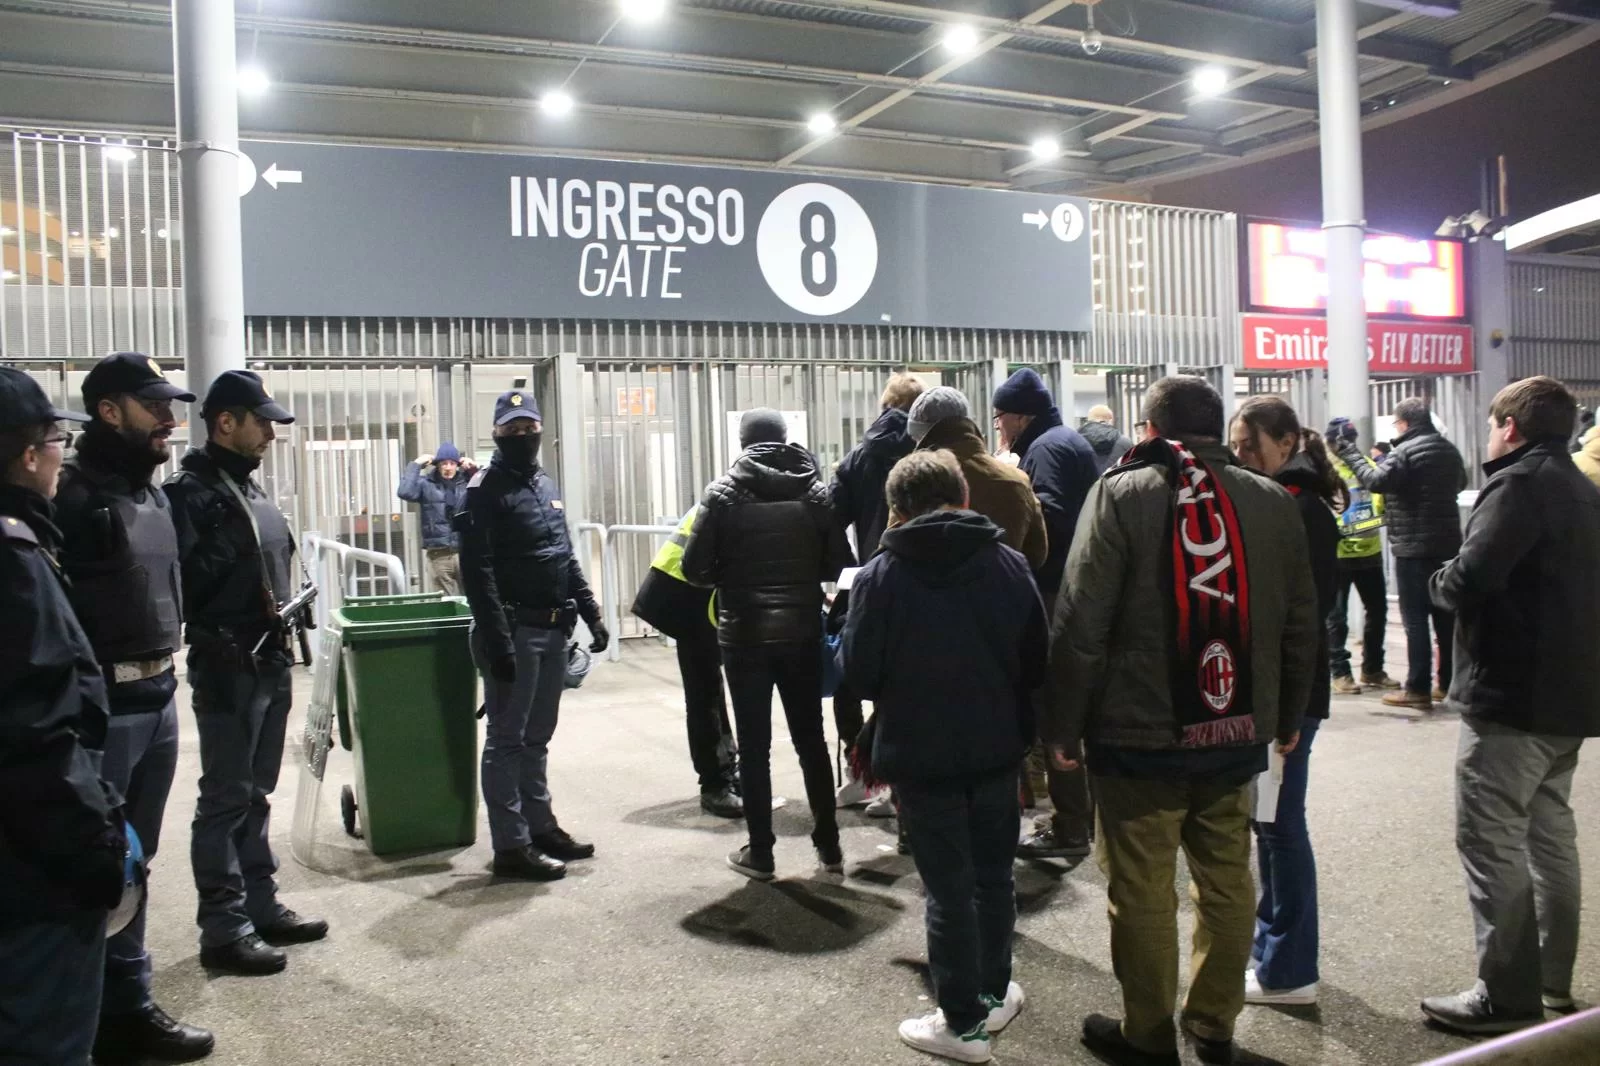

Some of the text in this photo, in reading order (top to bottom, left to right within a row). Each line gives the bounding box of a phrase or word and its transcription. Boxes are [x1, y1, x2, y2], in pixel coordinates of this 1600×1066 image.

[510, 176, 744, 246] INGRESSO
[1063, 209, 1072, 235] 9
[578, 242, 687, 299] GATE
[799, 201, 838, 298] 8
[1254, 326, 1464, 365] Emirs FLY BETTER
